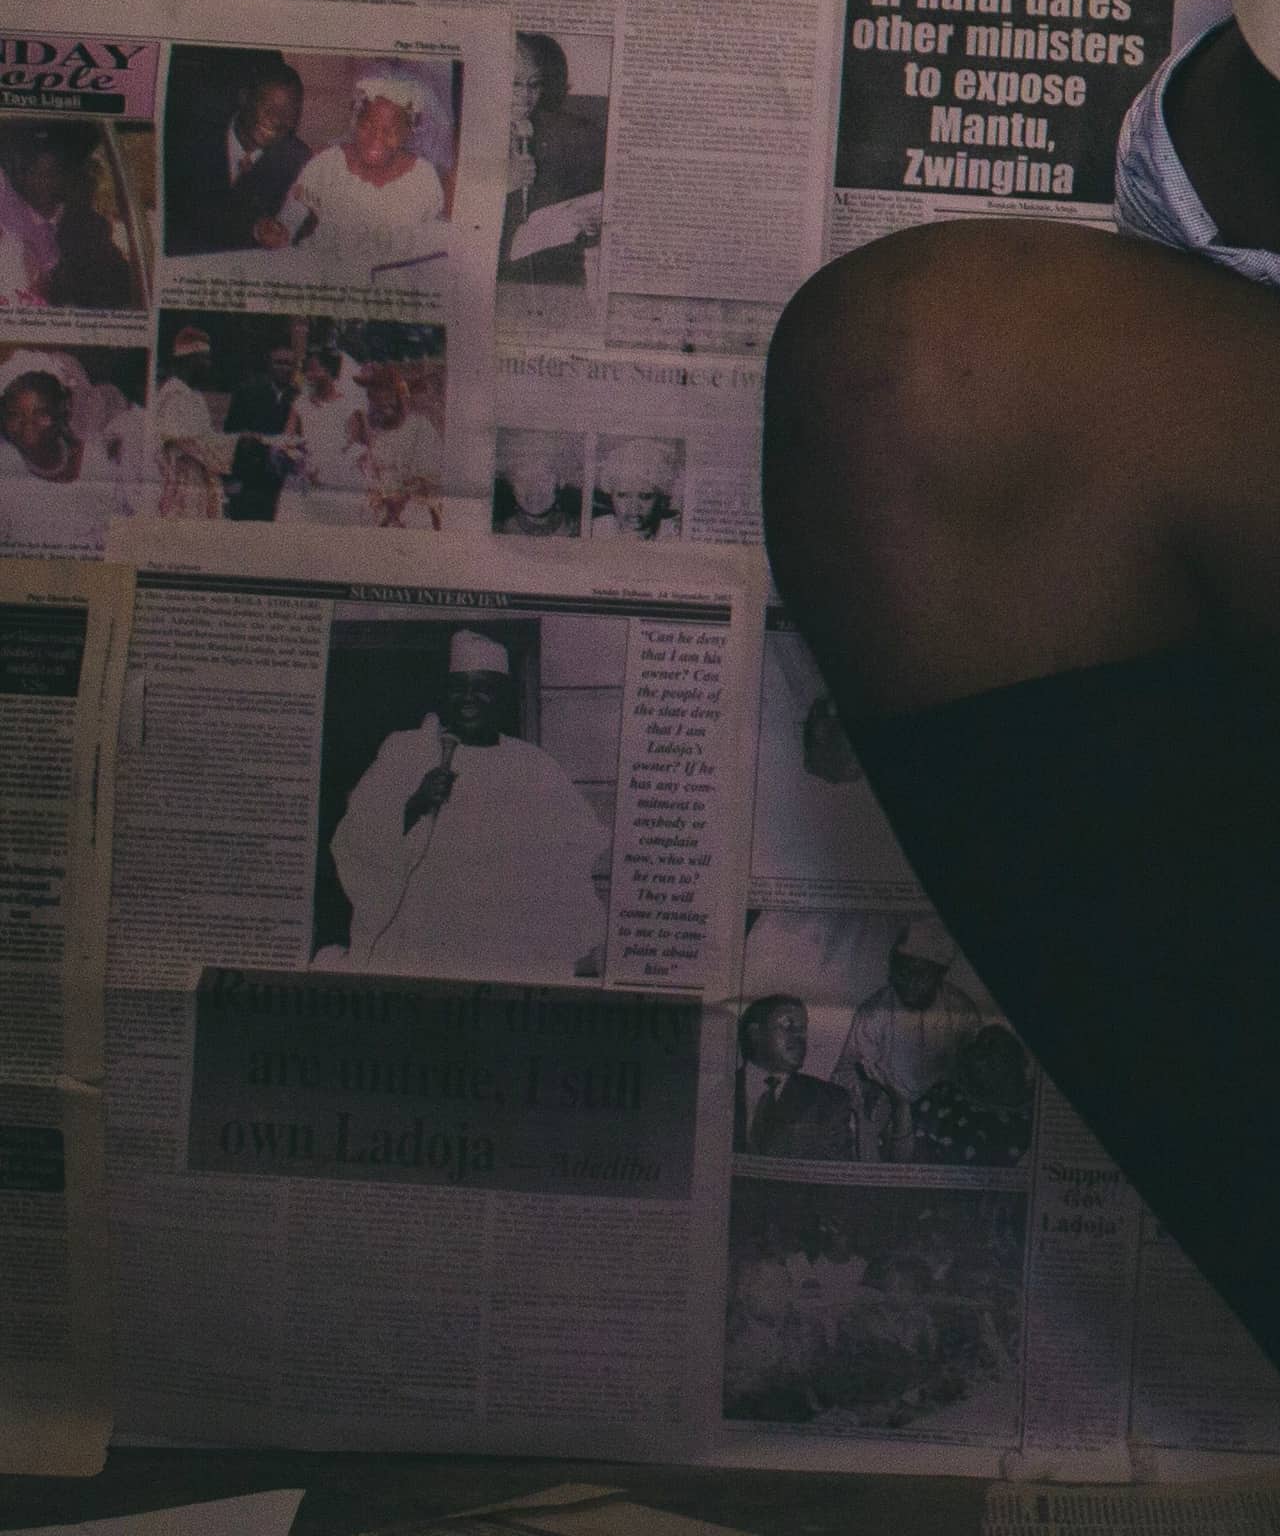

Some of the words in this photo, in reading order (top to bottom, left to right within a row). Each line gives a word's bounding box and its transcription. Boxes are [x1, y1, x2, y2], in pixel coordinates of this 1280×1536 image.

[851, 15, 954, 55] other
[965, 21, 1145, 66] ministers
[0, 64, 118, 94] ople
[904, 64, 940, 98] to
[954, 67, 1087, 108] expose
[930, 106, 1056, 152] Mantu,
[903, 147, 1075, 197] Zwingina
[350, 586, 413, 603] SUNDAY
[416, 588, 510, 609] INTERVIEW
[247, 1046, 321, 1089] are
[560, 1059, 644, 1111] still
[219, 1119, 315, 1160] own
[336, 1112, 496, 1185] Ladoja
